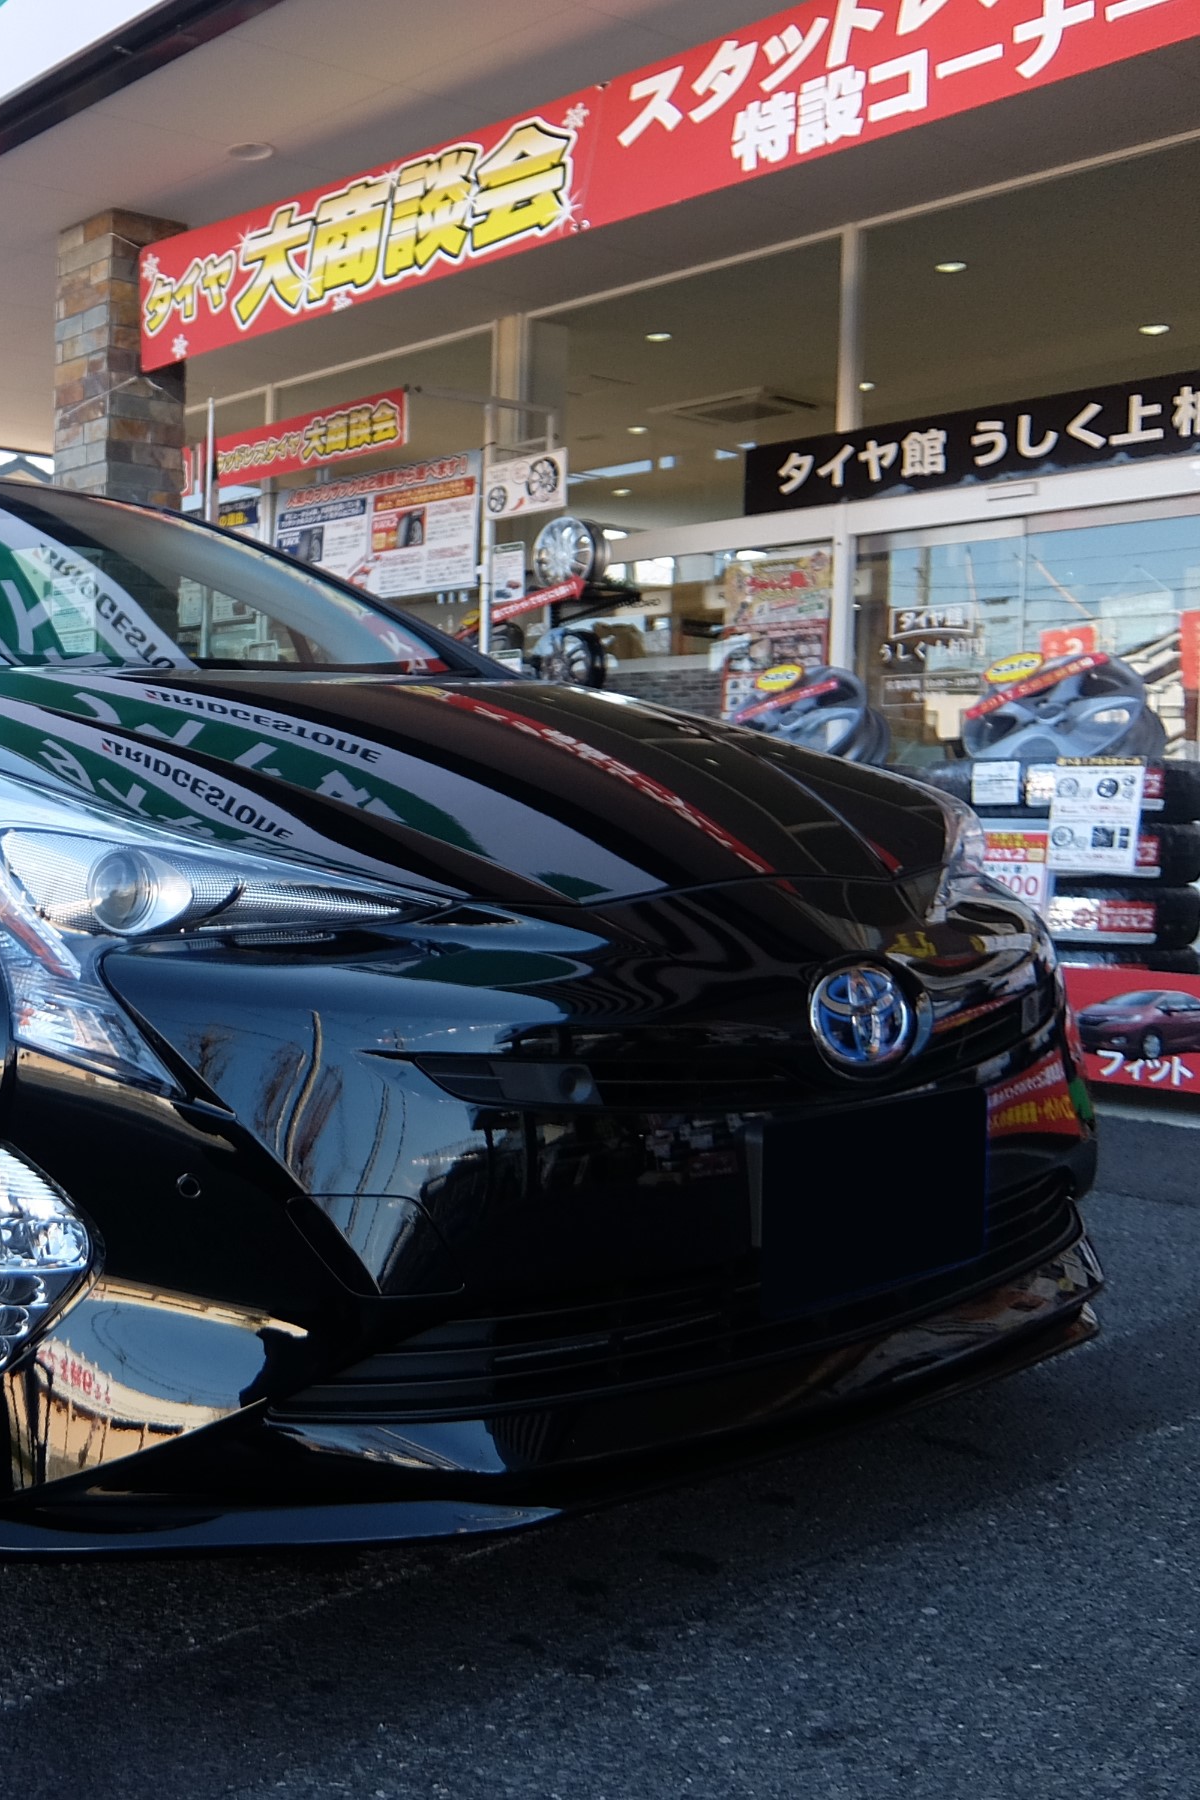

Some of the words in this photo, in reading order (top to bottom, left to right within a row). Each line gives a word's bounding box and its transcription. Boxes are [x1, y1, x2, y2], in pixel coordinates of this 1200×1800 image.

[231, 116, 578, 330] 大商談会
[301, 398, 400, 464] 大商談会
[777, 427, 949, 496] タイヤ館
[991, 657, 1038, 676] sale
[1097, 1050, 1195, 1087] フィット
